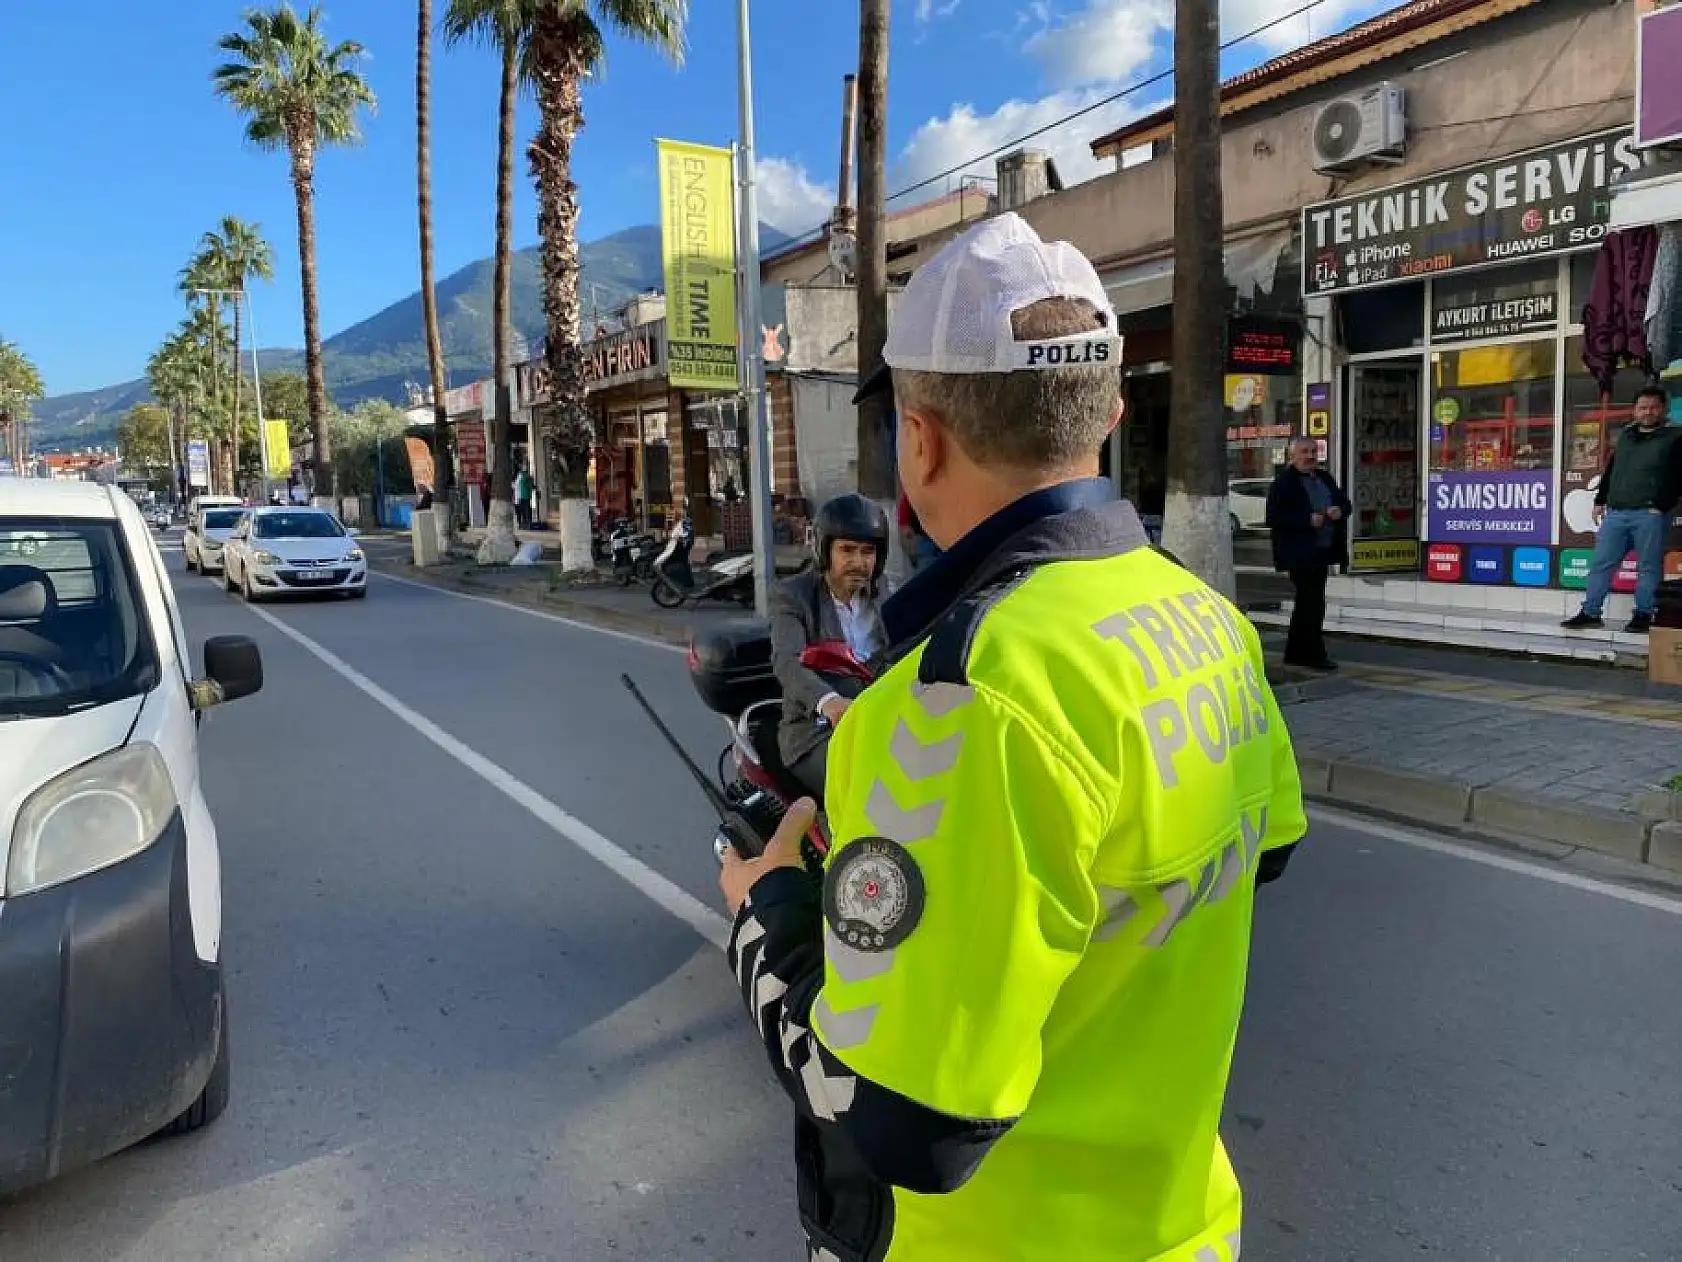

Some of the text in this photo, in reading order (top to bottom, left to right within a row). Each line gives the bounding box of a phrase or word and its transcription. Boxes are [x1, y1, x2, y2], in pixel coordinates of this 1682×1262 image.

[1549, 205, 1576, 225] LG
[684, 157, 710, 340] ENGLISH TIME
[1360, 242, 1411, 264] iPhone
[1361, 265, 1387, 283] iPad
[1437, 305, 1487, 328] AYKURT
[1436, 481, 1547, 510] SAMSUNG
